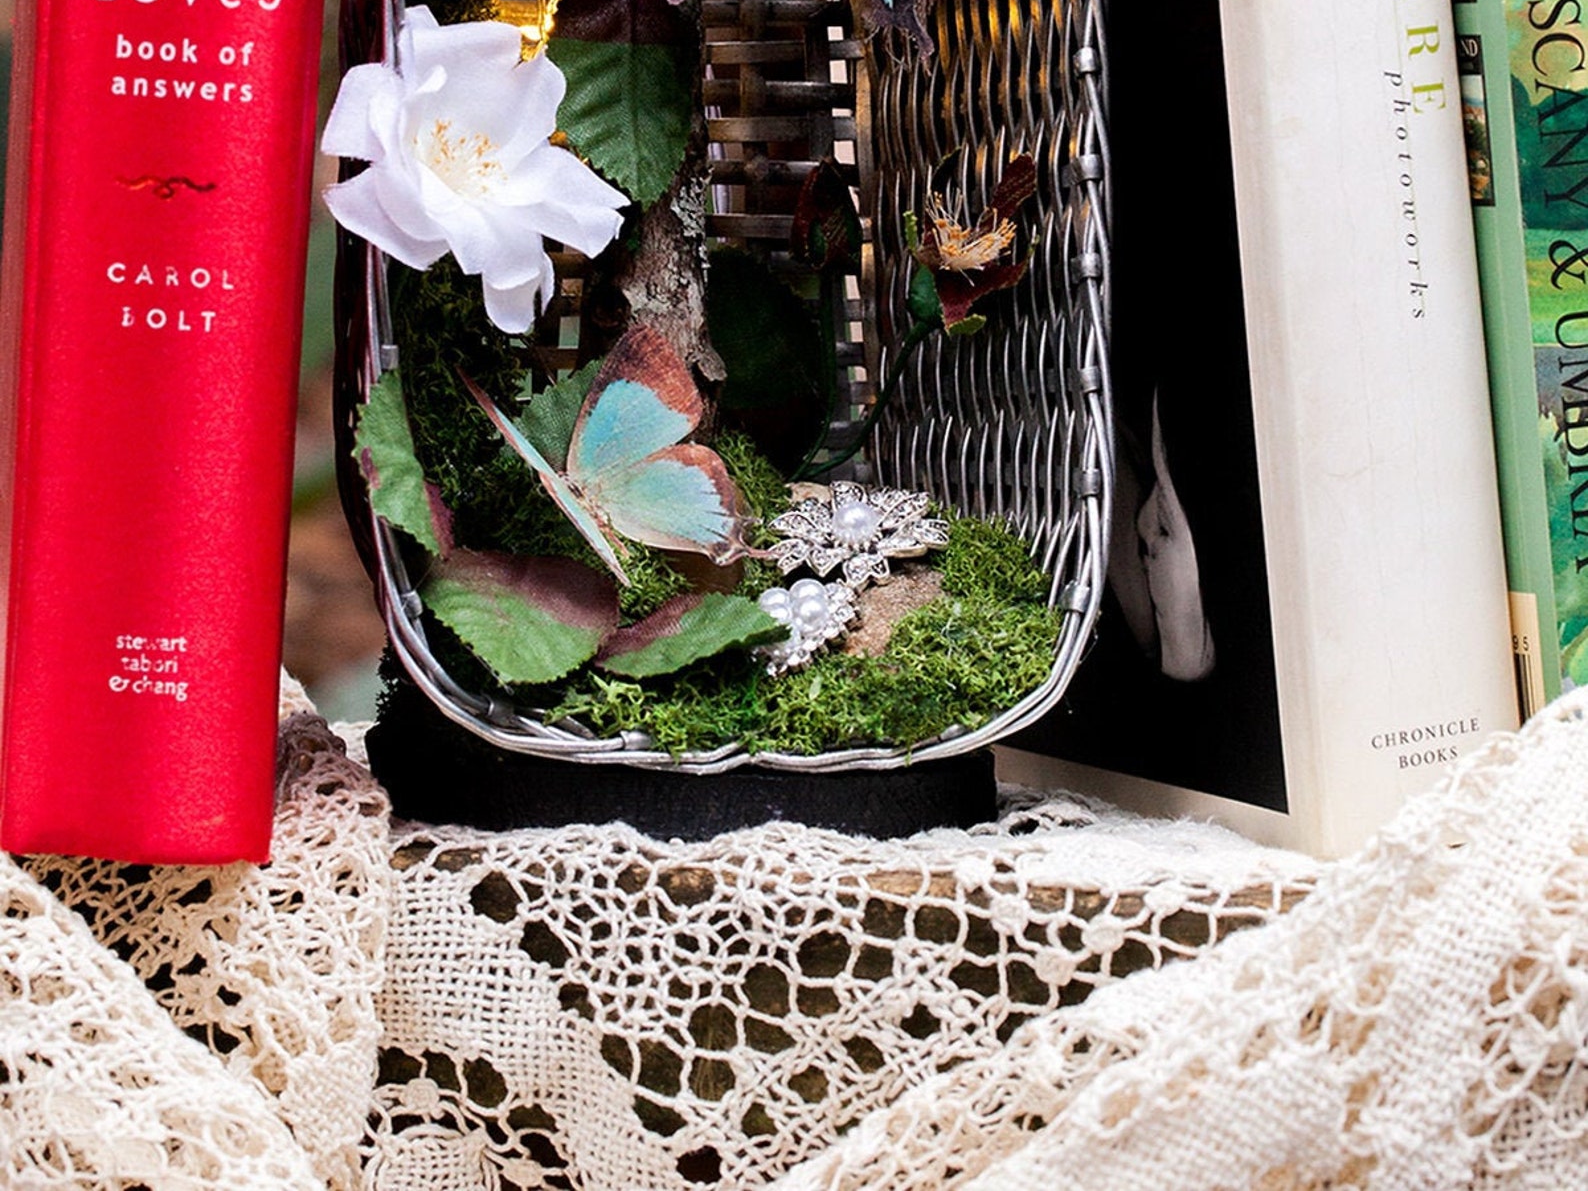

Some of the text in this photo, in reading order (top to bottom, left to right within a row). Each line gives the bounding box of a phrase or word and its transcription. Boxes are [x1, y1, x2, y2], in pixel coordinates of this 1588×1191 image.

[116, 34, 255, 66] book of
[111, 75, 254, 103] answers
[1384, 71, 1429, 319] photoworks
[106, 262, 234, 290] CAROL
[1548, 239, 1588, 291] &
[121, 306, 217, 333] BOLT
[1555, 311, 1588, 574] UMB
[120, 653, 178, 673] tabori
[108, 675, 188, 702] & chang
[1371, 717, 1481, 749] CHRONICLE
[1399, 745, 1458, 769] BOOKS
